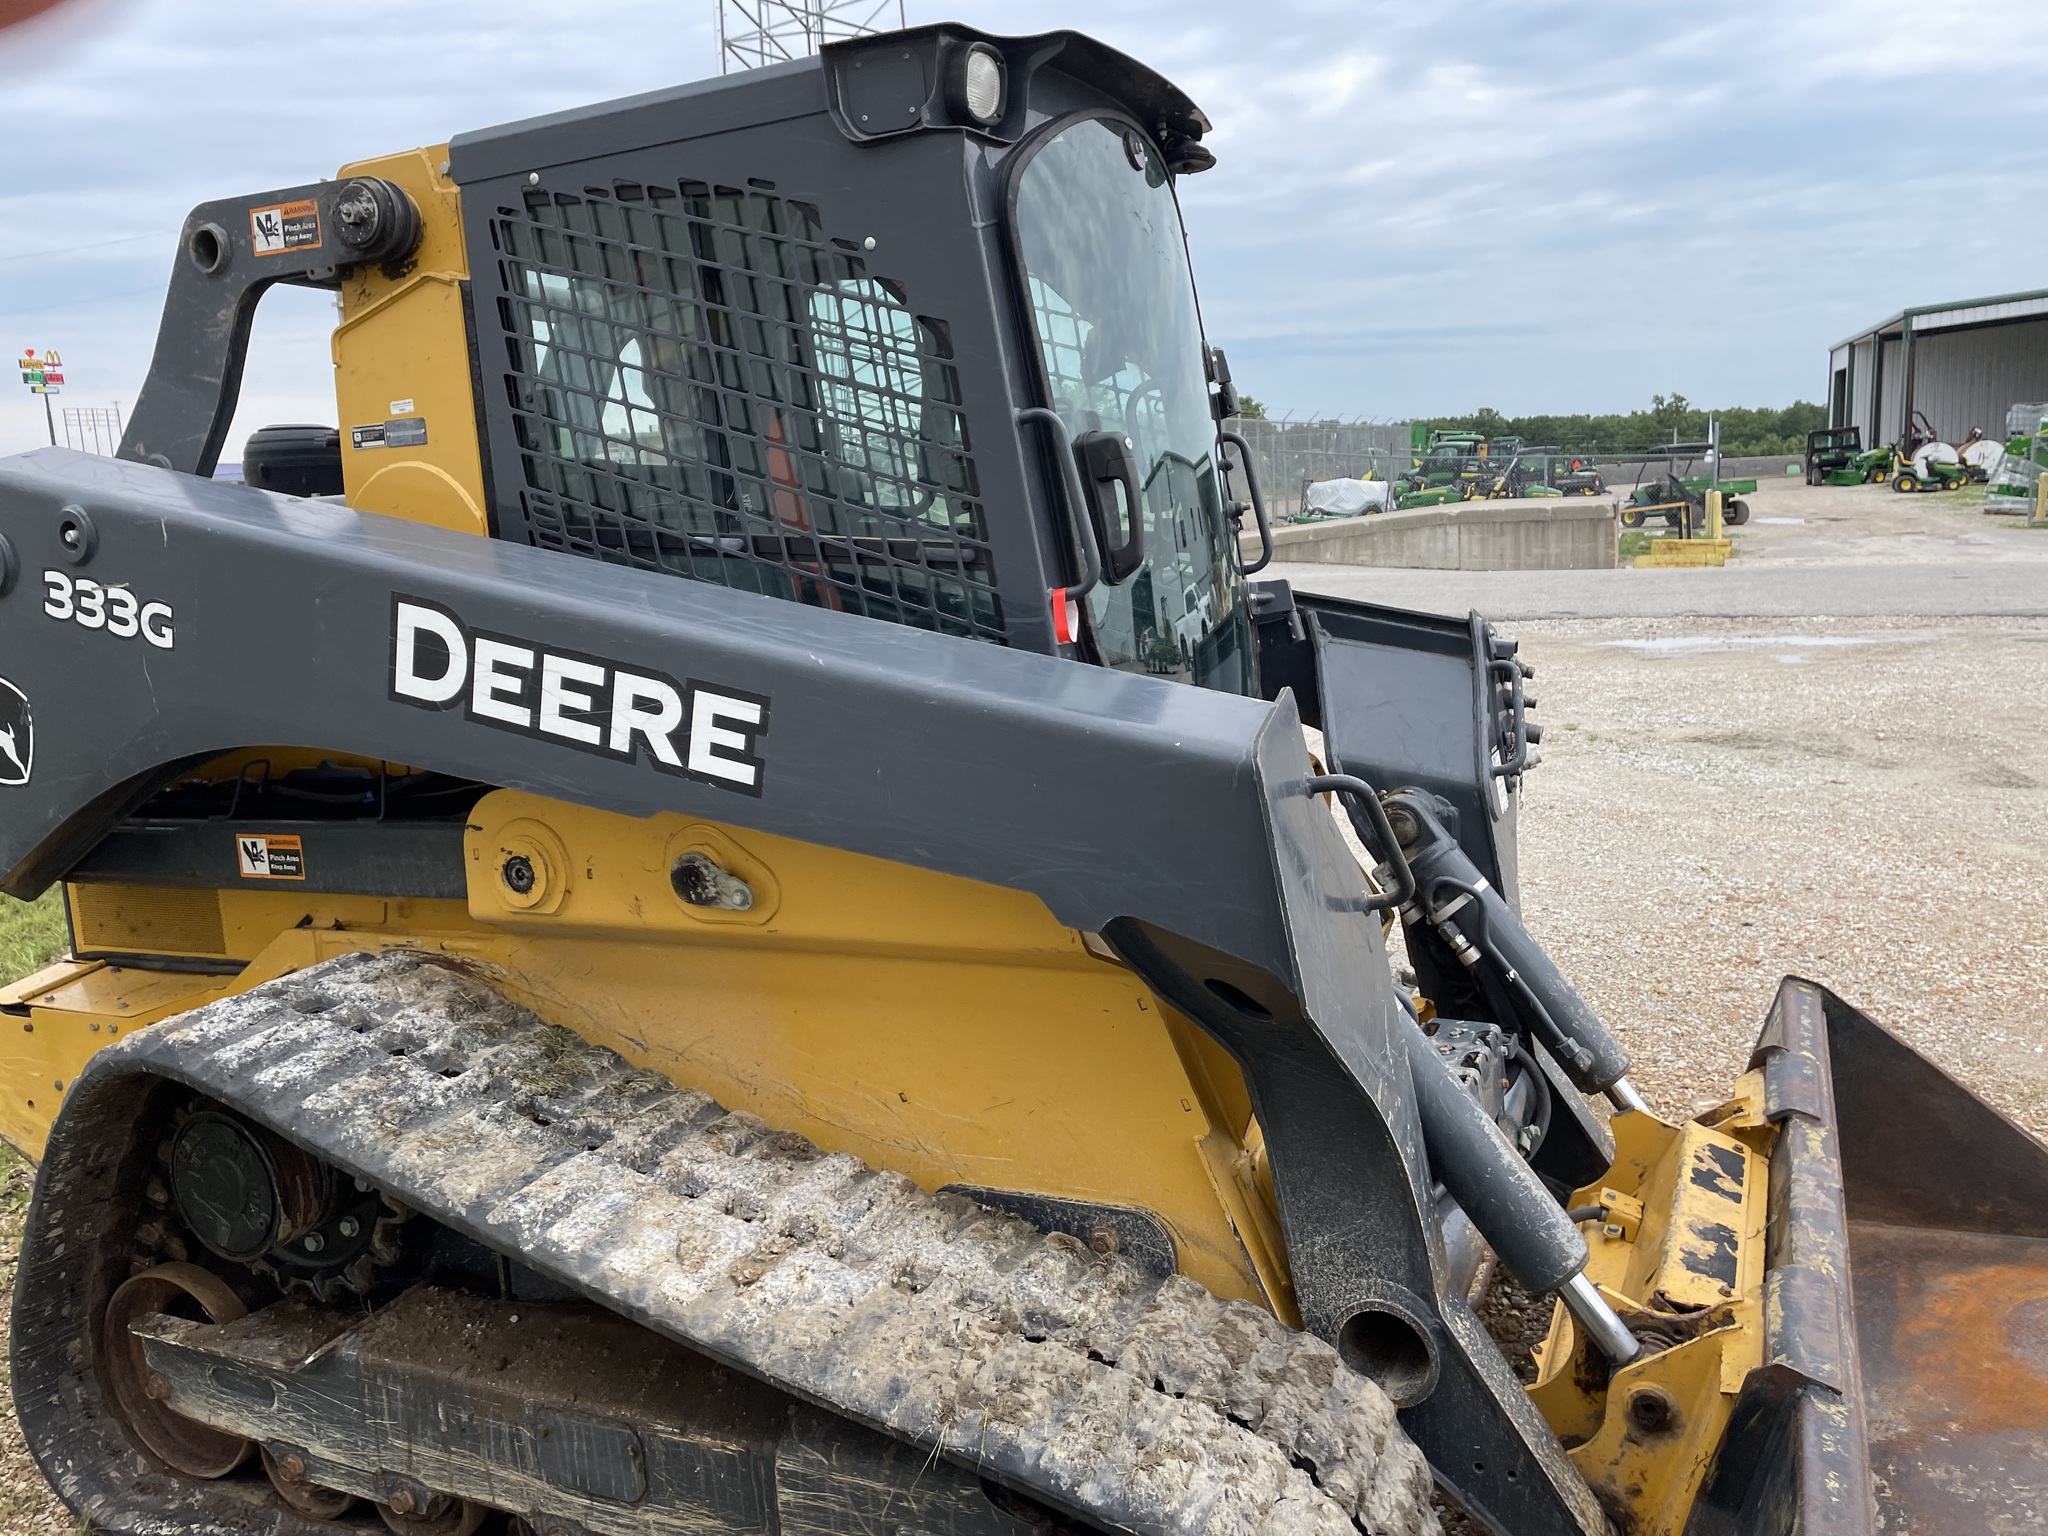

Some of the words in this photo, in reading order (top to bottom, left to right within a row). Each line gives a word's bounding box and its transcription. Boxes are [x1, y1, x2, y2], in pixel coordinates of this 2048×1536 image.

[284, 223, 302, 232] Pinch
[289, 205, 315, 213] WARNING
[42, 570, 174, 649] 333G
[394, 602, 762, 786] DEERE
